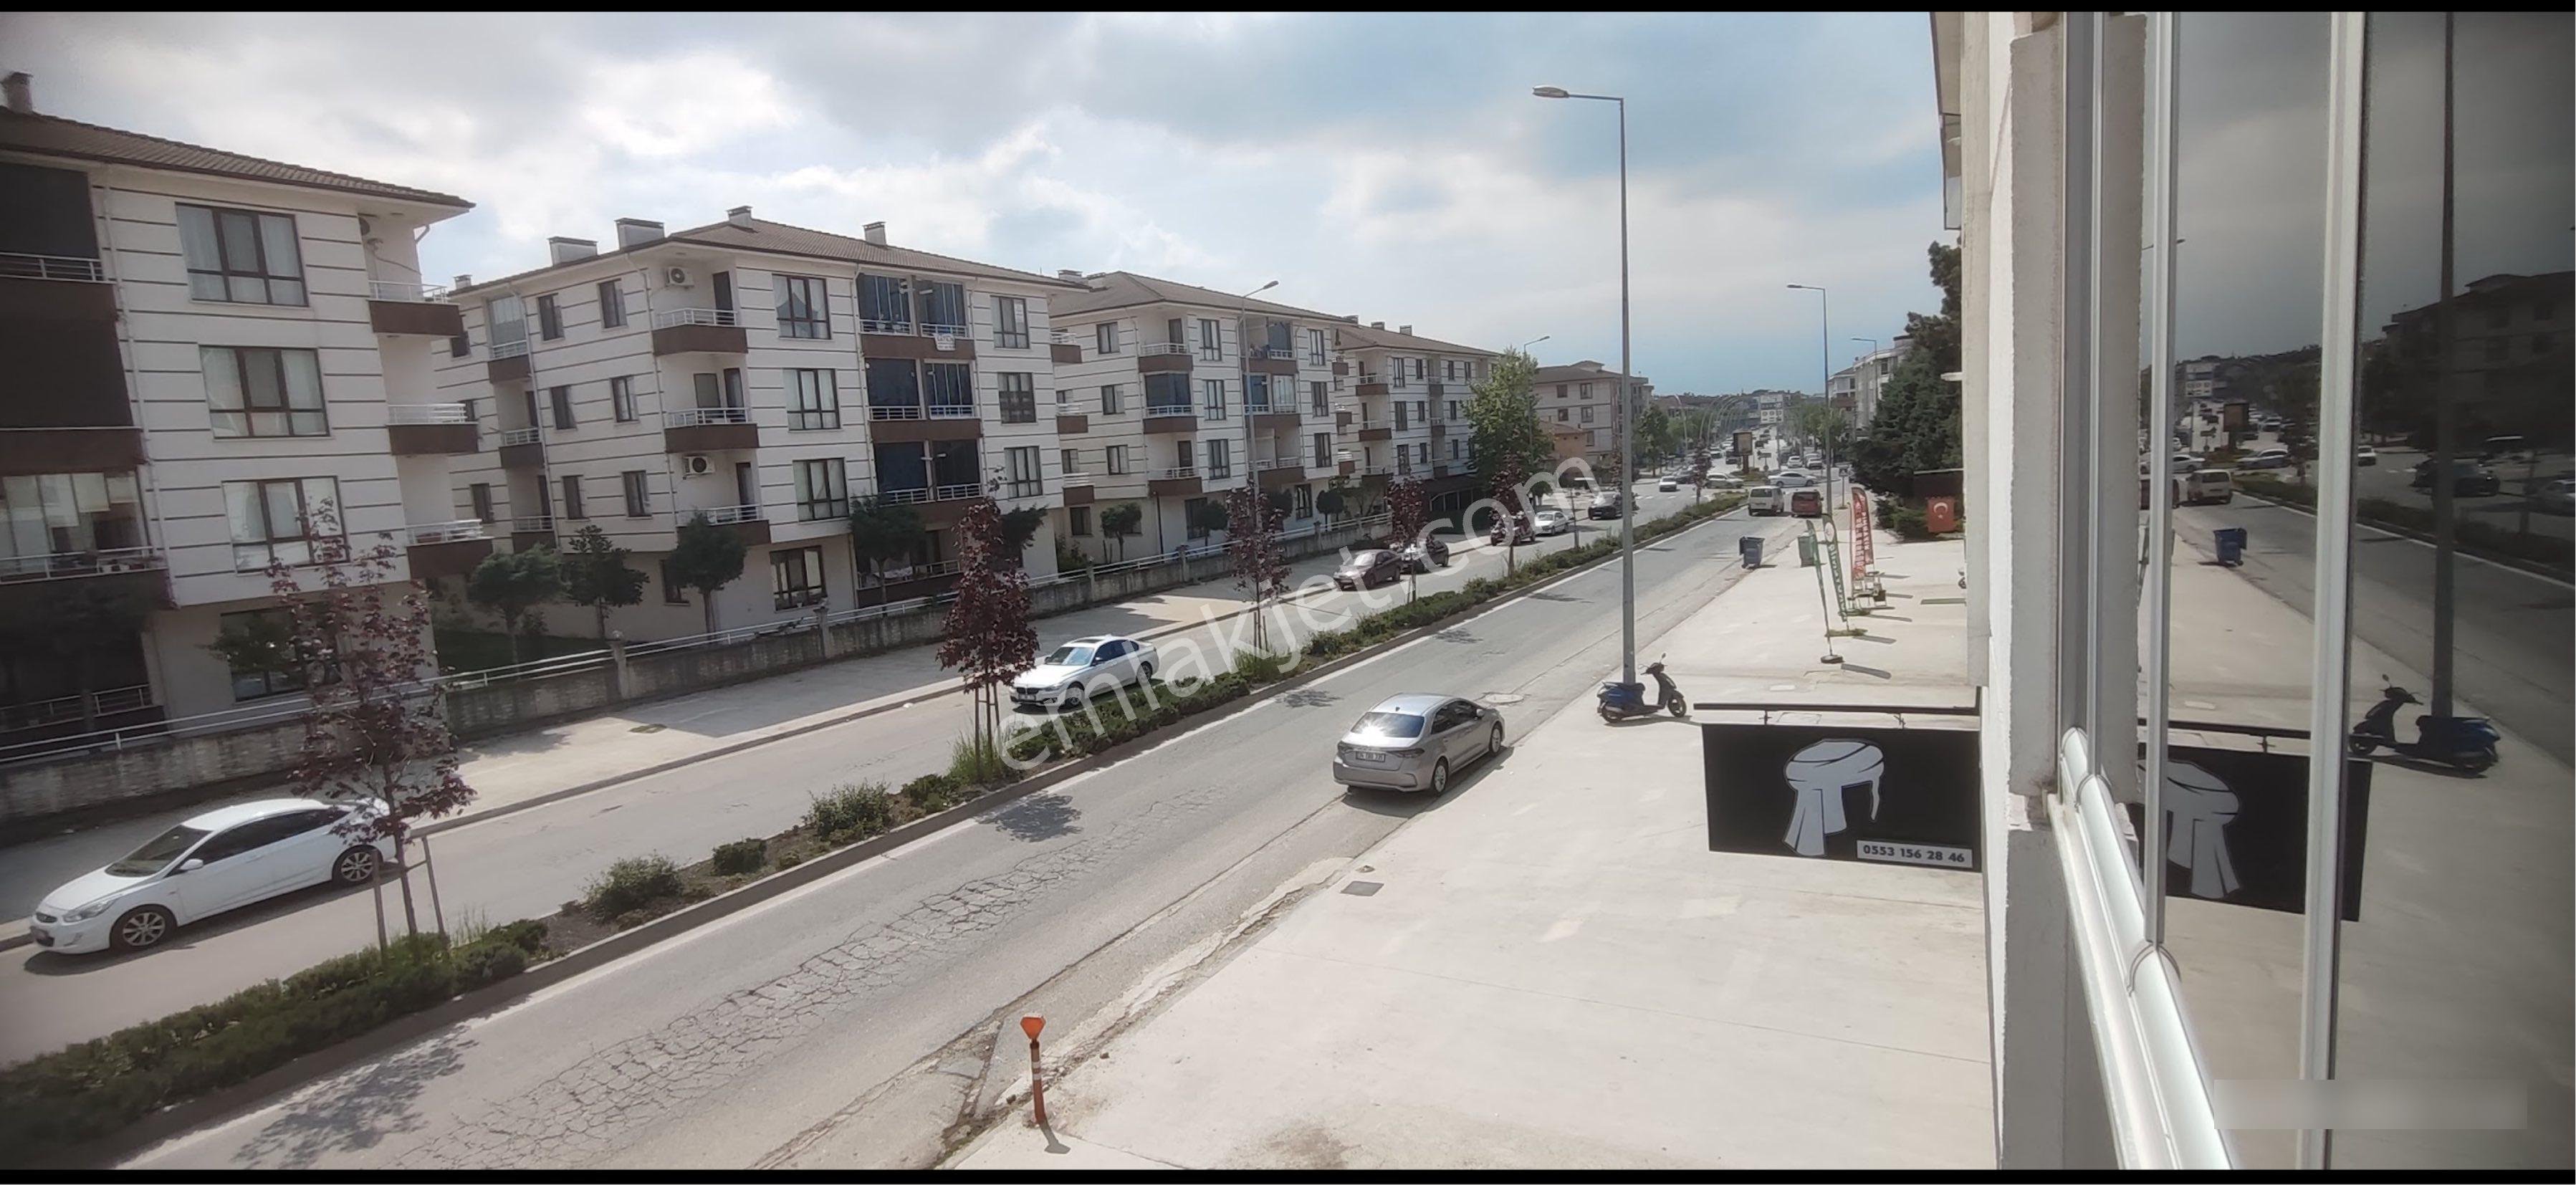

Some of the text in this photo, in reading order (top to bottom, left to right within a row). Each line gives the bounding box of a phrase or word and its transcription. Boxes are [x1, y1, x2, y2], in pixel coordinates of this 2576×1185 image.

[1863, 845, 1965, 863] 0553 156 28 46
